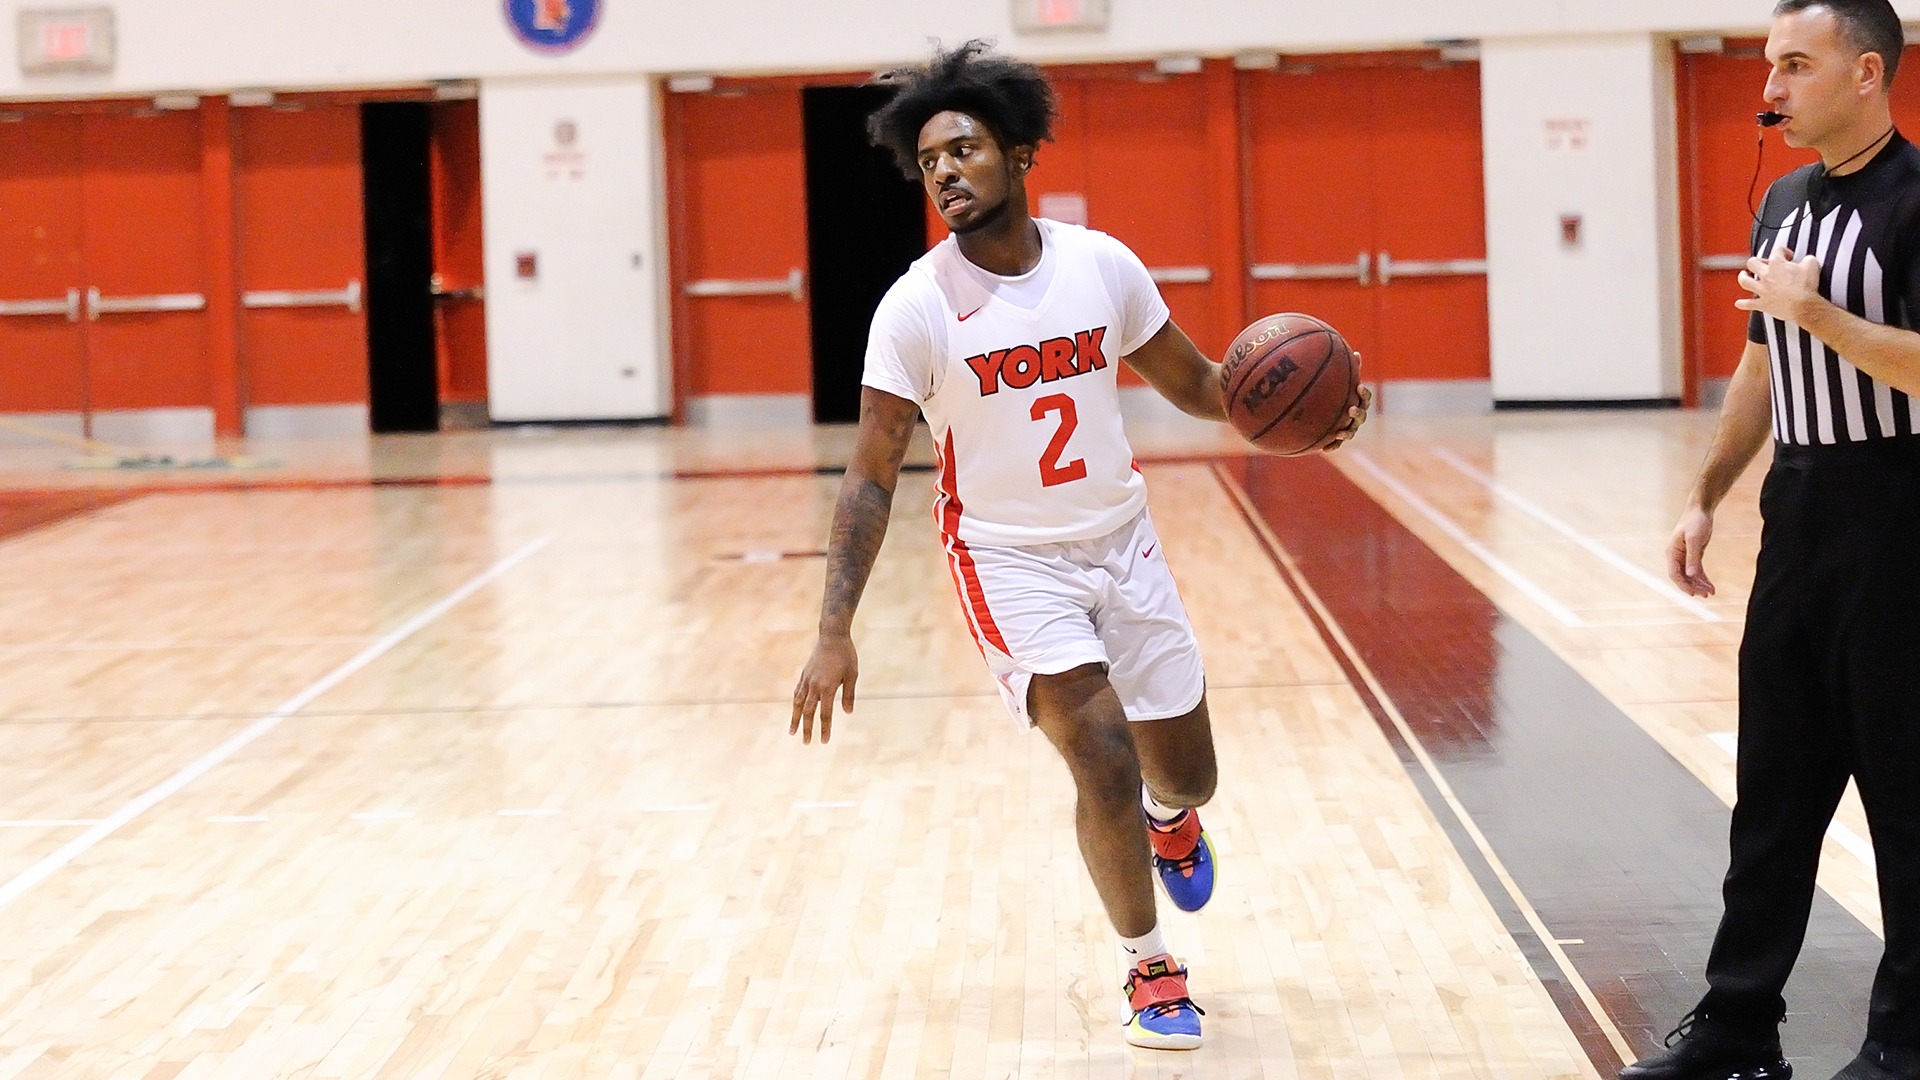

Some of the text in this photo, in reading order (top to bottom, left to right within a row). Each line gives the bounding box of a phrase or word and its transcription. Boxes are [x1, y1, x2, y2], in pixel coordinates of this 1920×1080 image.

[965, 326, 1107, 396] YORK
[1242, 355, 1300, 413] NCAA
[1029, 392, 1087, 488] 2
